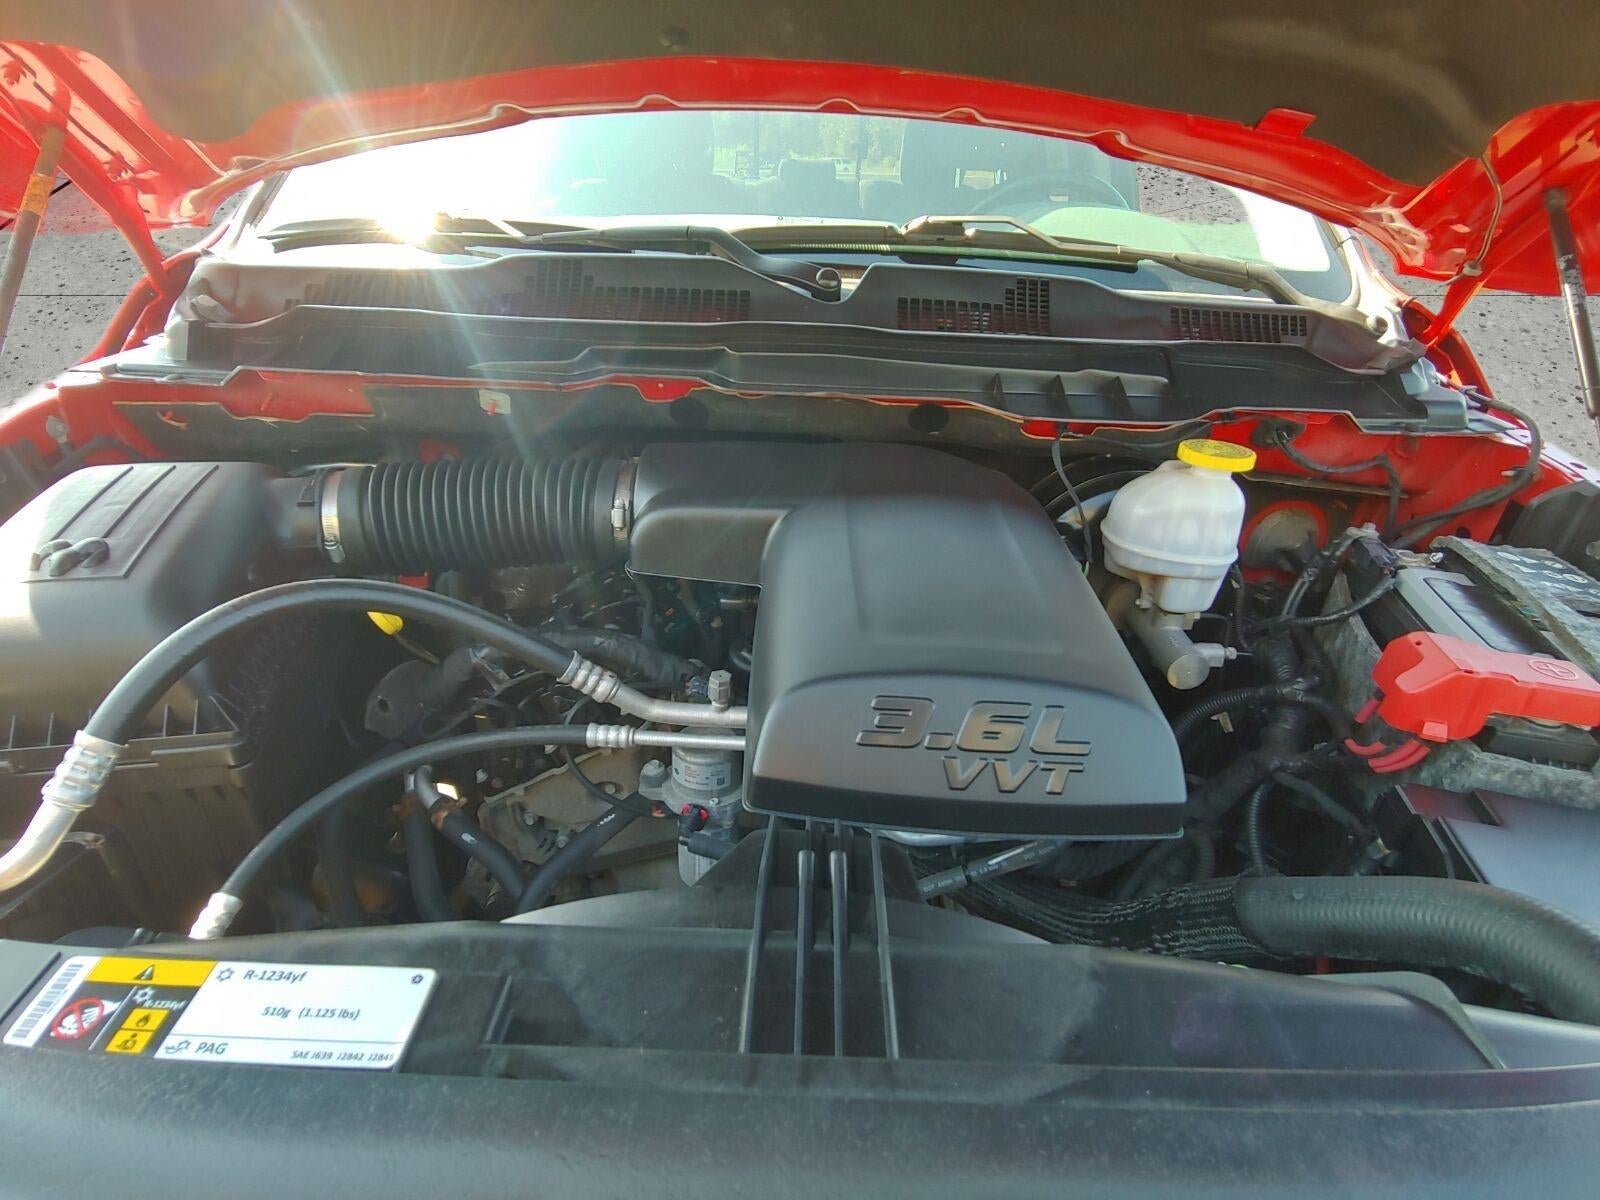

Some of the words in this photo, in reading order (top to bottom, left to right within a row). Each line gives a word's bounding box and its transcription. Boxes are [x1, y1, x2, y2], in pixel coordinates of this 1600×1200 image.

[856, 695, 1092, 756] 3.6L
[941, 756, 1085, 795] VVT
[243, 970, 308, 984] R-1234yf
[261, 1006, 291, 1019] 510g
[298, 1006, 336, 1019] (1.125
[337, 1008, 361, 1021] lbs)
[195, 1042, 228, 1055] PAG
[289, 1050, 311, 1060] SAE
